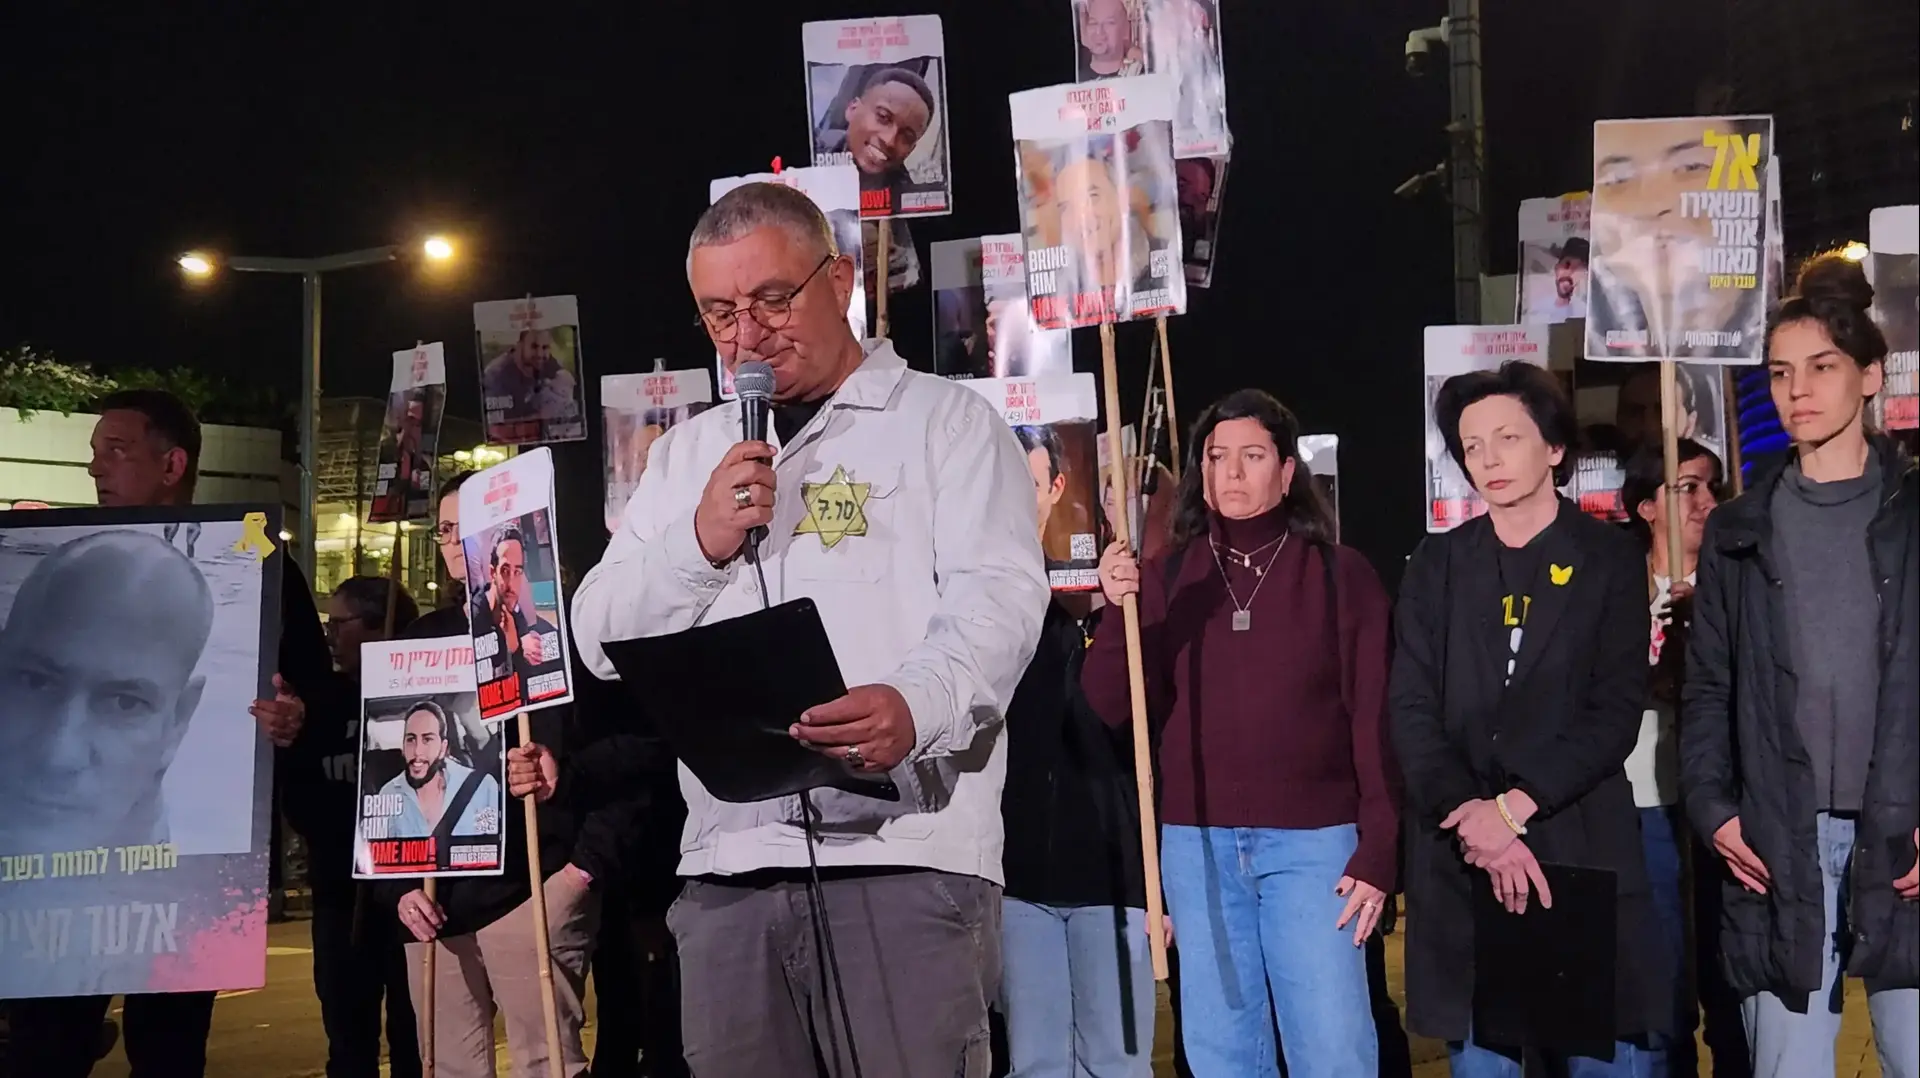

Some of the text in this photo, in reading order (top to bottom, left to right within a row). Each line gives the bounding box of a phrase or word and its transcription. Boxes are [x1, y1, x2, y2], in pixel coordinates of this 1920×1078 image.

[1703, 129, 1761, 190] אל
[1680, 191, 1759, 218] תשאירו
[1712, 218, 1759, 247] אותי
[1028, 245, 1069, 273] BRING
[1030, 270, 1057, 296] HIM
[817, 497, 855, 521] 7.10
[390, 647, 475, 674] מתן עדיין חי
[363, 793, 403, 817] BRING
[363, 817, 389, 839] HIM
[50, 845, 110, 879] למוות
[114, 842, 179, 876] הופקר
[368, 836, 437, 866] OME NOW!
[83, 901, 179, 956] אלעד
